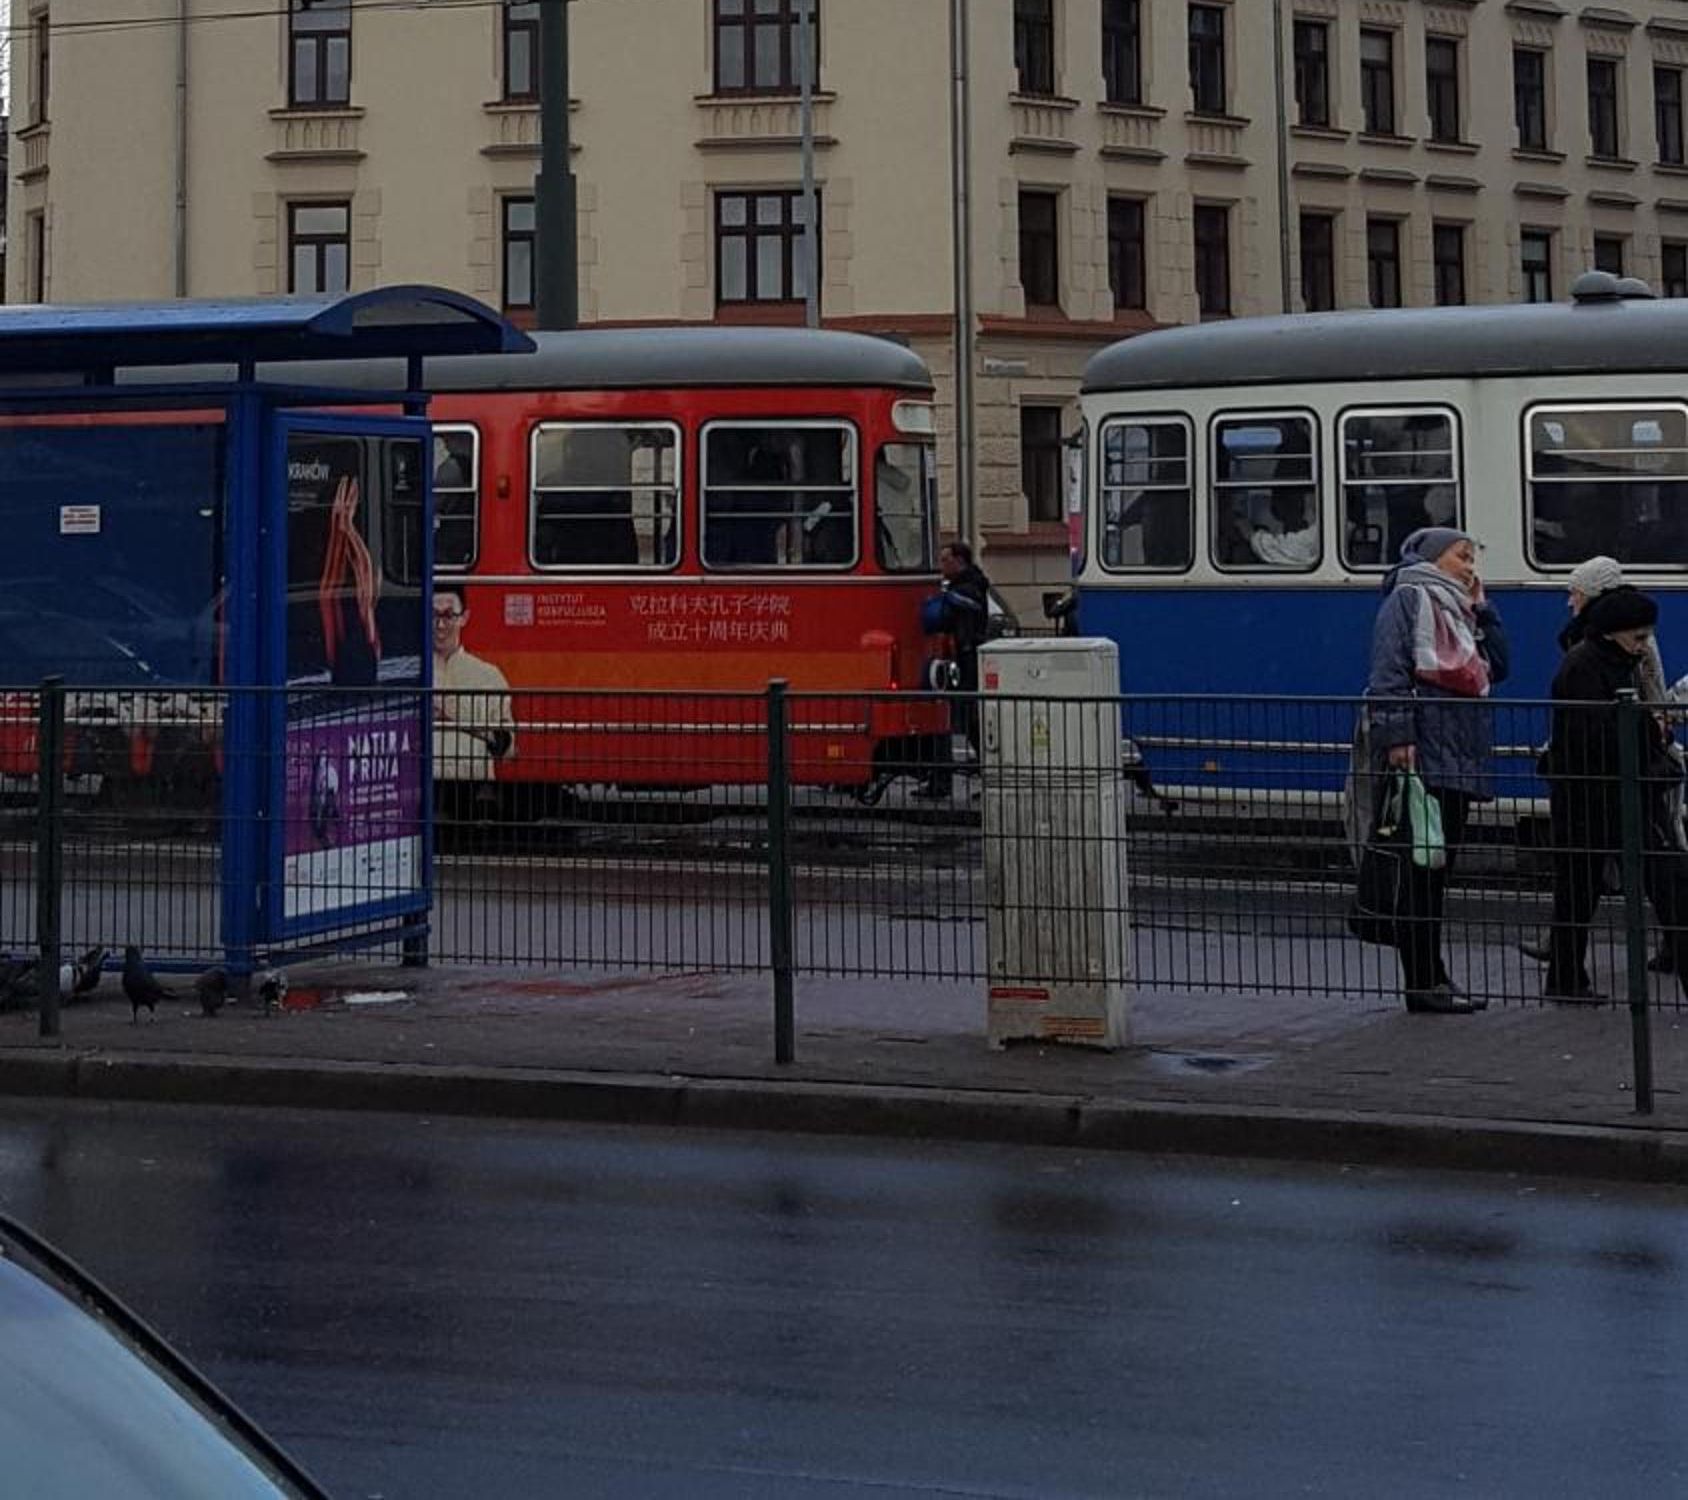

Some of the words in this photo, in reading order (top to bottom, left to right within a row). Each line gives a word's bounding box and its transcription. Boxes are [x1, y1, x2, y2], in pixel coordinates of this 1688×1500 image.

[646, 619, 789, 641] 成立十周年庆典
